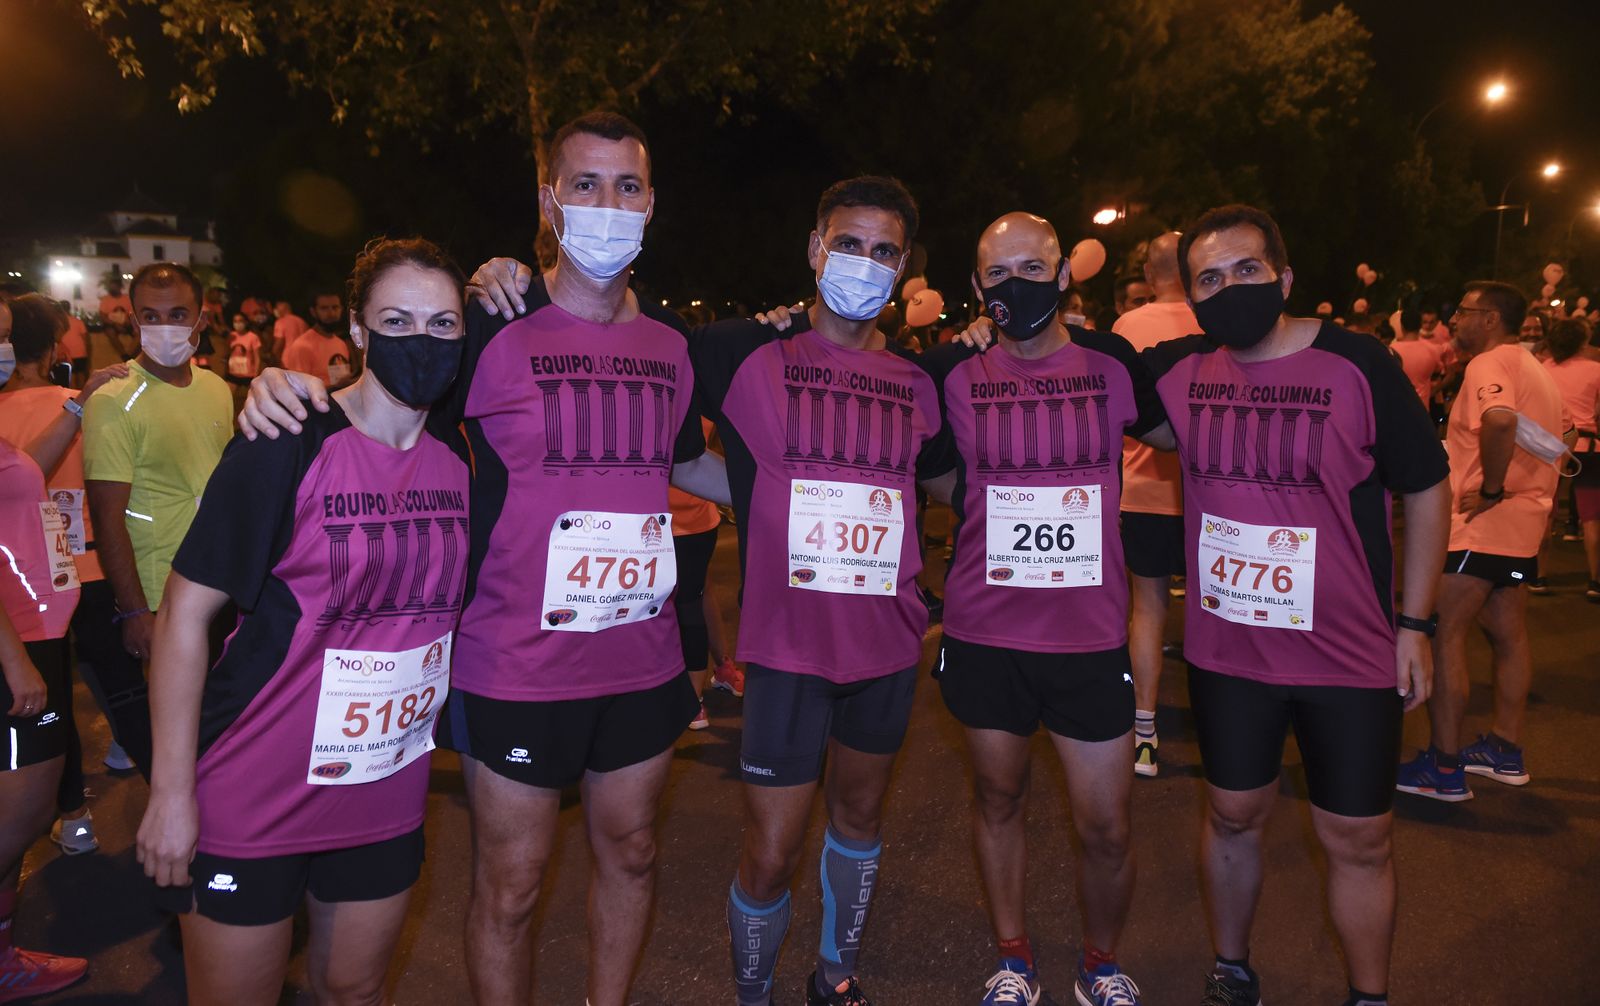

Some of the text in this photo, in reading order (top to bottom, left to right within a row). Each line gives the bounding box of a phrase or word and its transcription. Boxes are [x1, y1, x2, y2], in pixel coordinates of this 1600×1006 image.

[1013, 523, 1075, 552] 266
[790, 554, 820, 562] ANTONIO
[988, 554, 1020, 563] ALBERTO
[566, 556, 657, 590] 4761
[1210, 554, 1293, 594] 4776
[566, 594, 597, 603] DANIEL
[627, 593, 654, 601] RIVERA
[1210, 584, 1230, 597] TOMAS
[1231, 591, 1262, 603] MARTOS
[1264, 597, 1294, 606] MILLAN
[342, 686, 436, 738] 5182
[315, 744, 344, 753] MARIA
[348, 743, 364, 752] DEL
[367, 739, 386, 751] MAR
[846, 860, 879, 943] kalenji
[742, 914, 768, 979] kalenji
